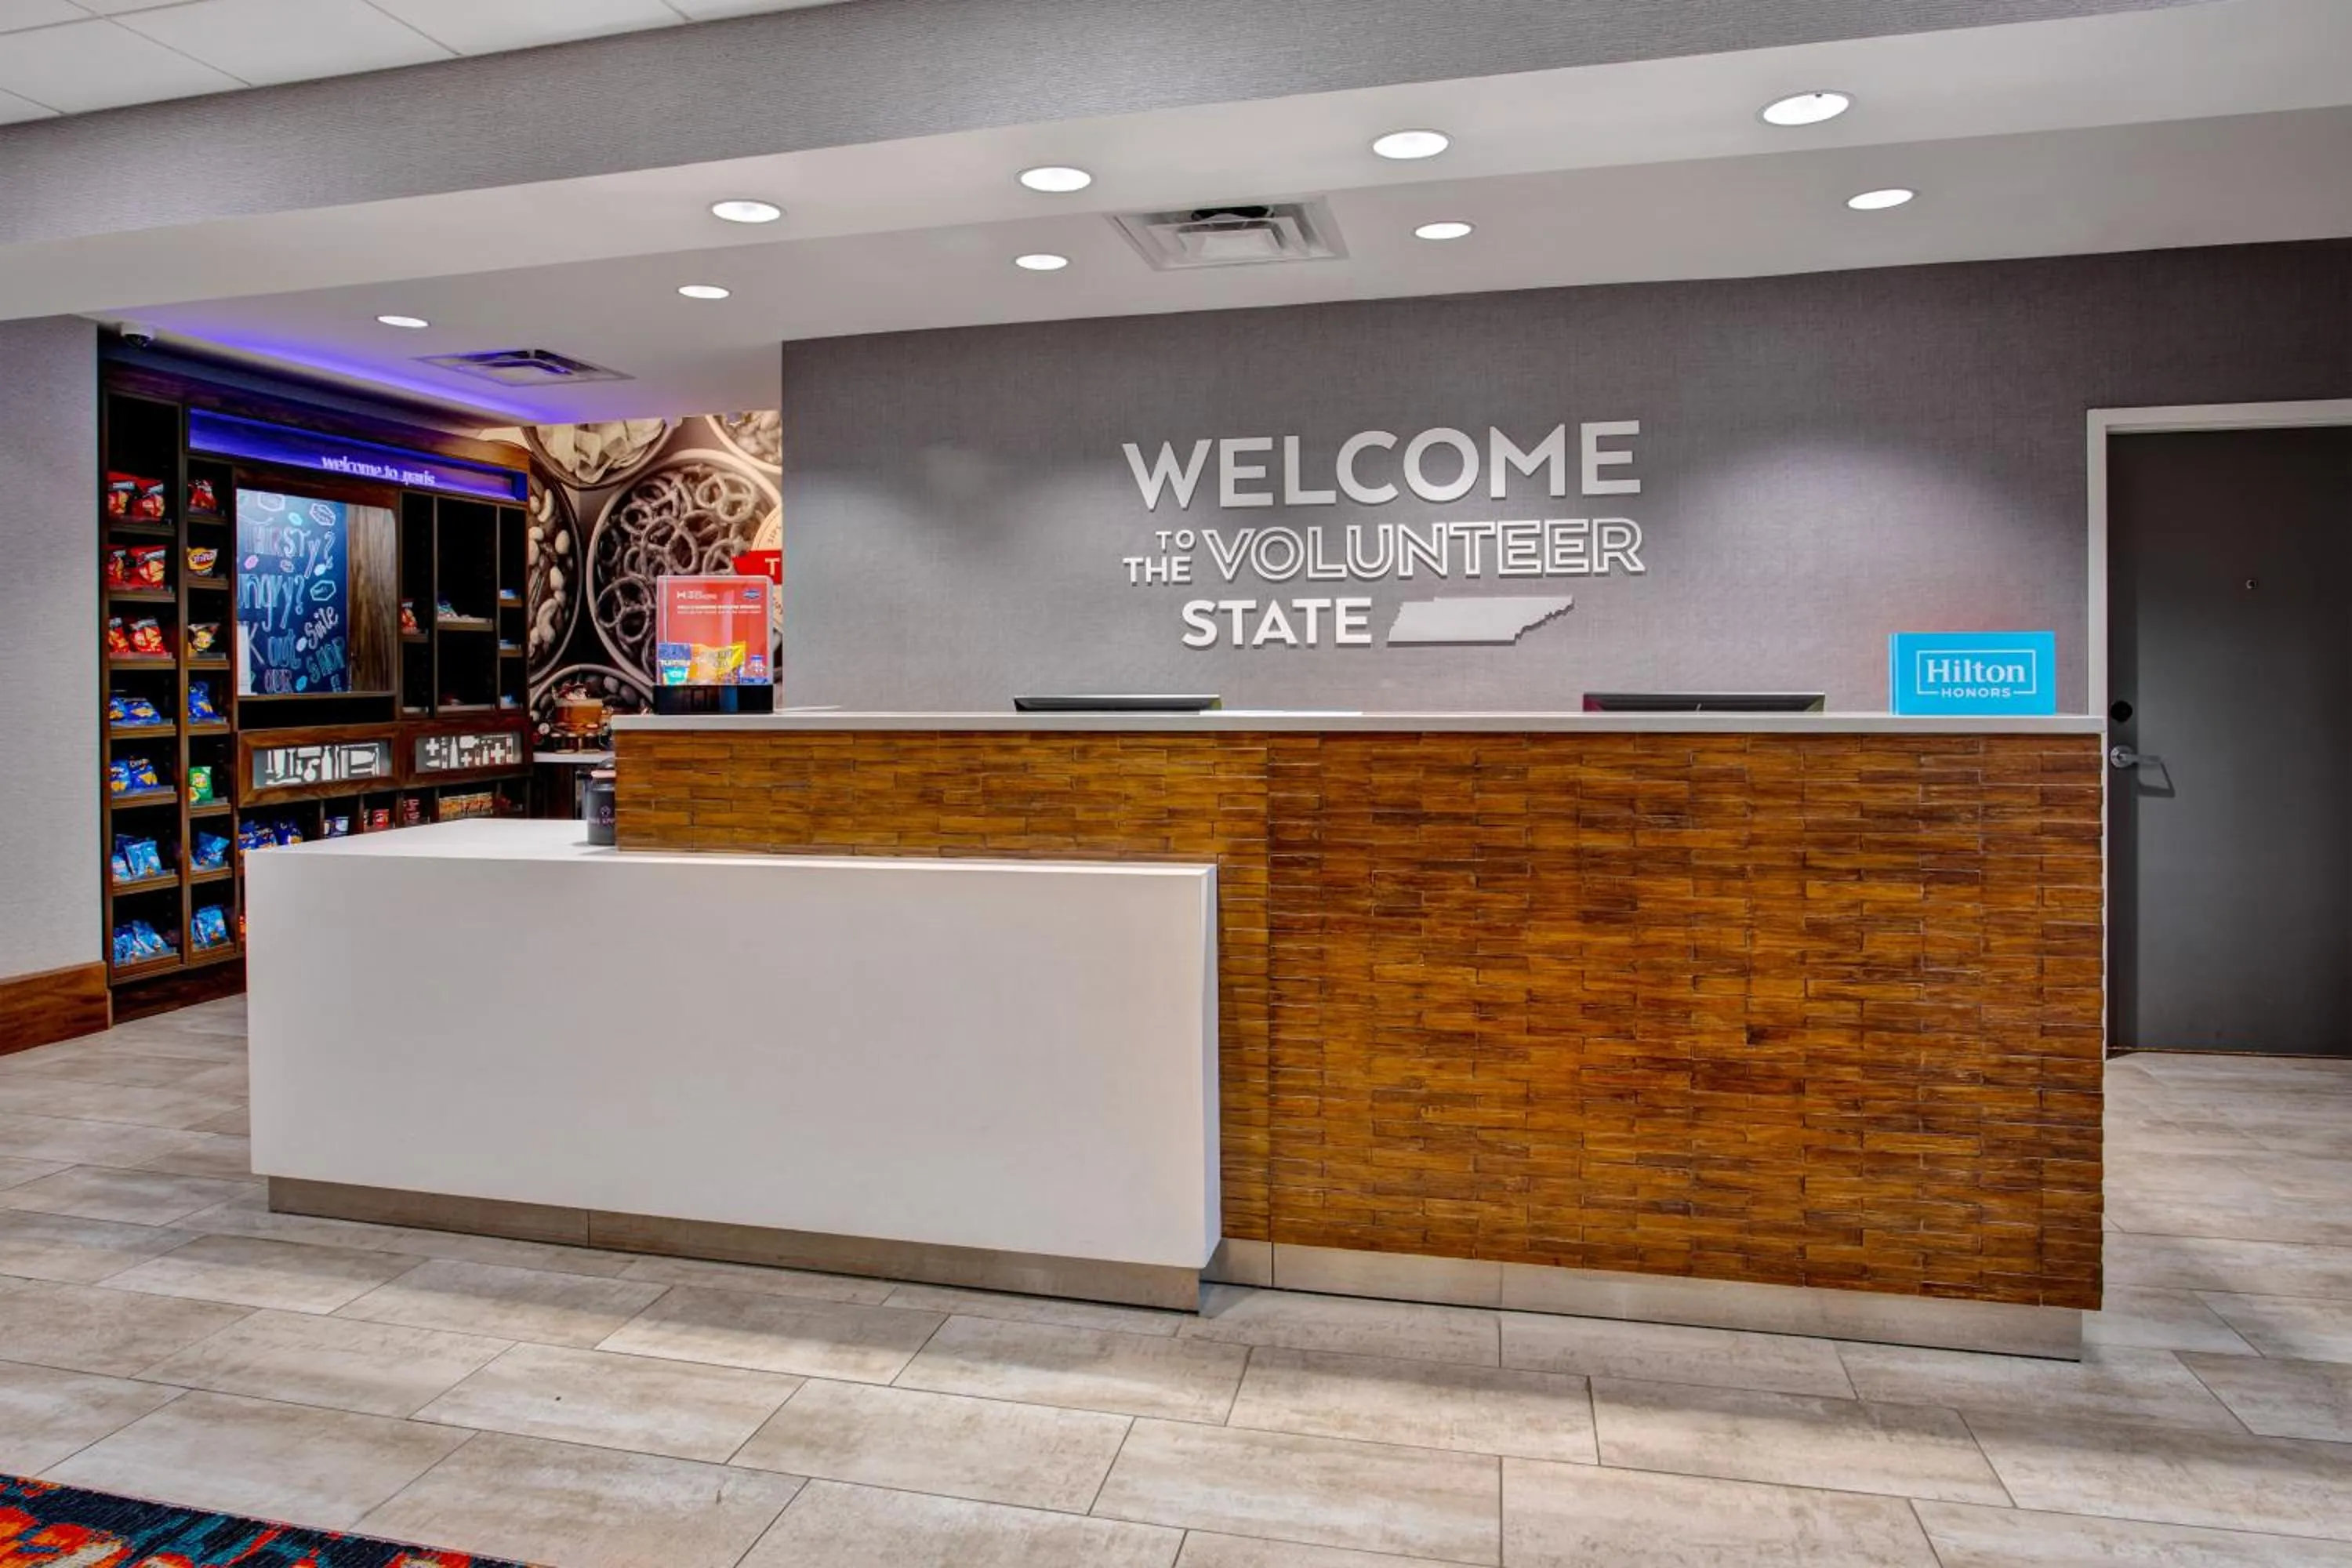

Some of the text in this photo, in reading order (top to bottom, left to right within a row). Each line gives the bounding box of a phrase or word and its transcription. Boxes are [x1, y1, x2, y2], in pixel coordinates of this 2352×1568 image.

[321, 456, 383, 477] welcome
[384, 465, 398, 480] to
[1122, 420, 1641, 510] WELCOME
[1155, 529, 1196, 551] TO
[1201, 517, 1646, 581] VOLUNTEER
[1123, 556, 1192, 584] THE
[1181, 597, 1373, 647] STATE
[1926, 659, 2026, 684] Hilton
[1941, 687, 2012, 699] HONORS
